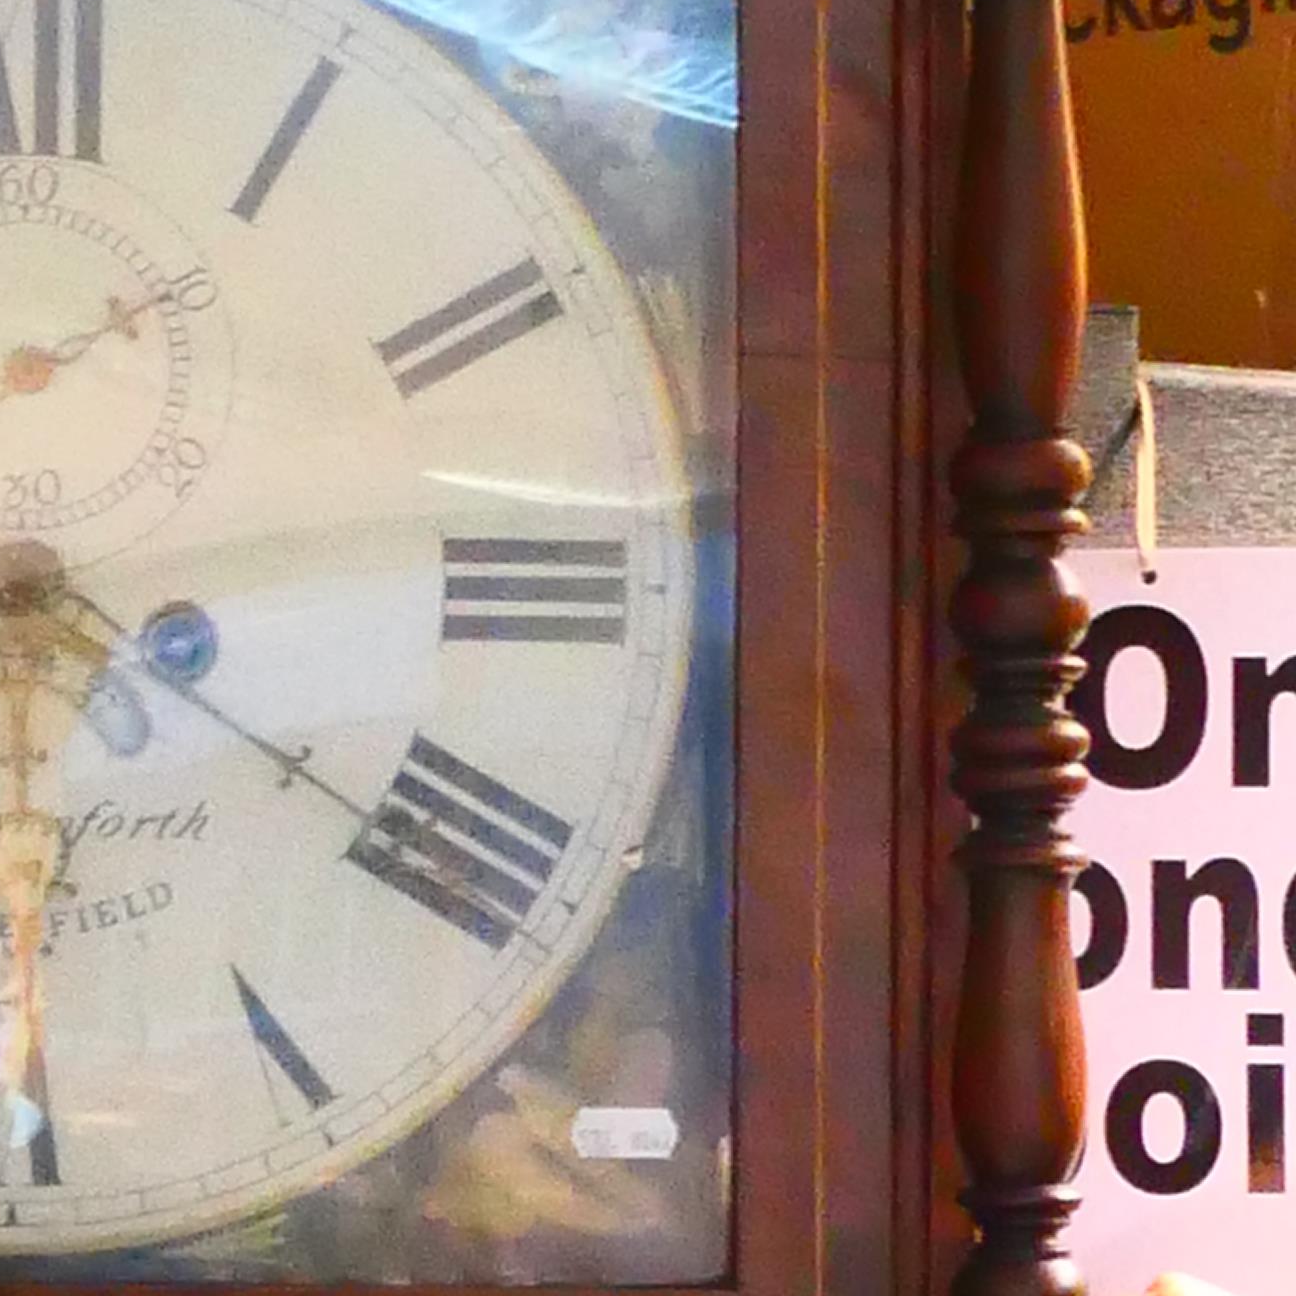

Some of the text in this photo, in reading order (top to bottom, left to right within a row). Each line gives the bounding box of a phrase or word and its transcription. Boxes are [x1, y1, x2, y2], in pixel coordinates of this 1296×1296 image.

[228, 55, 344, 226] I
[368, 255, 566, 401] II
[3, 469, 62, 507] 30
[439, 534, 628, 647] III
[229, 962, 342, 1128] V
